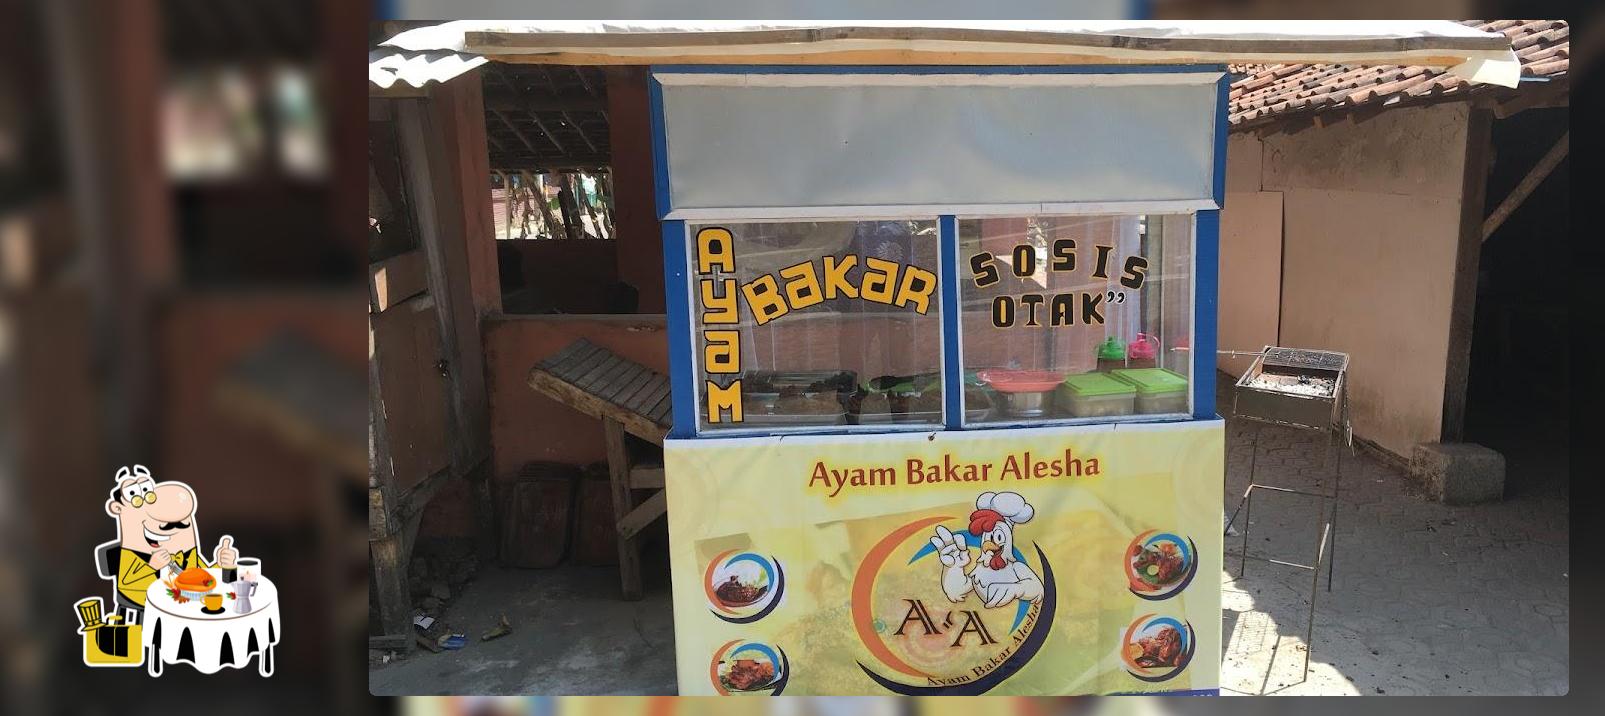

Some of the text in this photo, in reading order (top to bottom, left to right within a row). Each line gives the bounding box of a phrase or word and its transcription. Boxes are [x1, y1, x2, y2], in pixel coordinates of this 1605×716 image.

[969, 239, 1149, 290] SOSIS
[808, 449, 1100, 498] Ayam Bakar Alesha
[972, 647, 1010, 677] Bakar
[1012, 602, 1039, 647] Alesha
